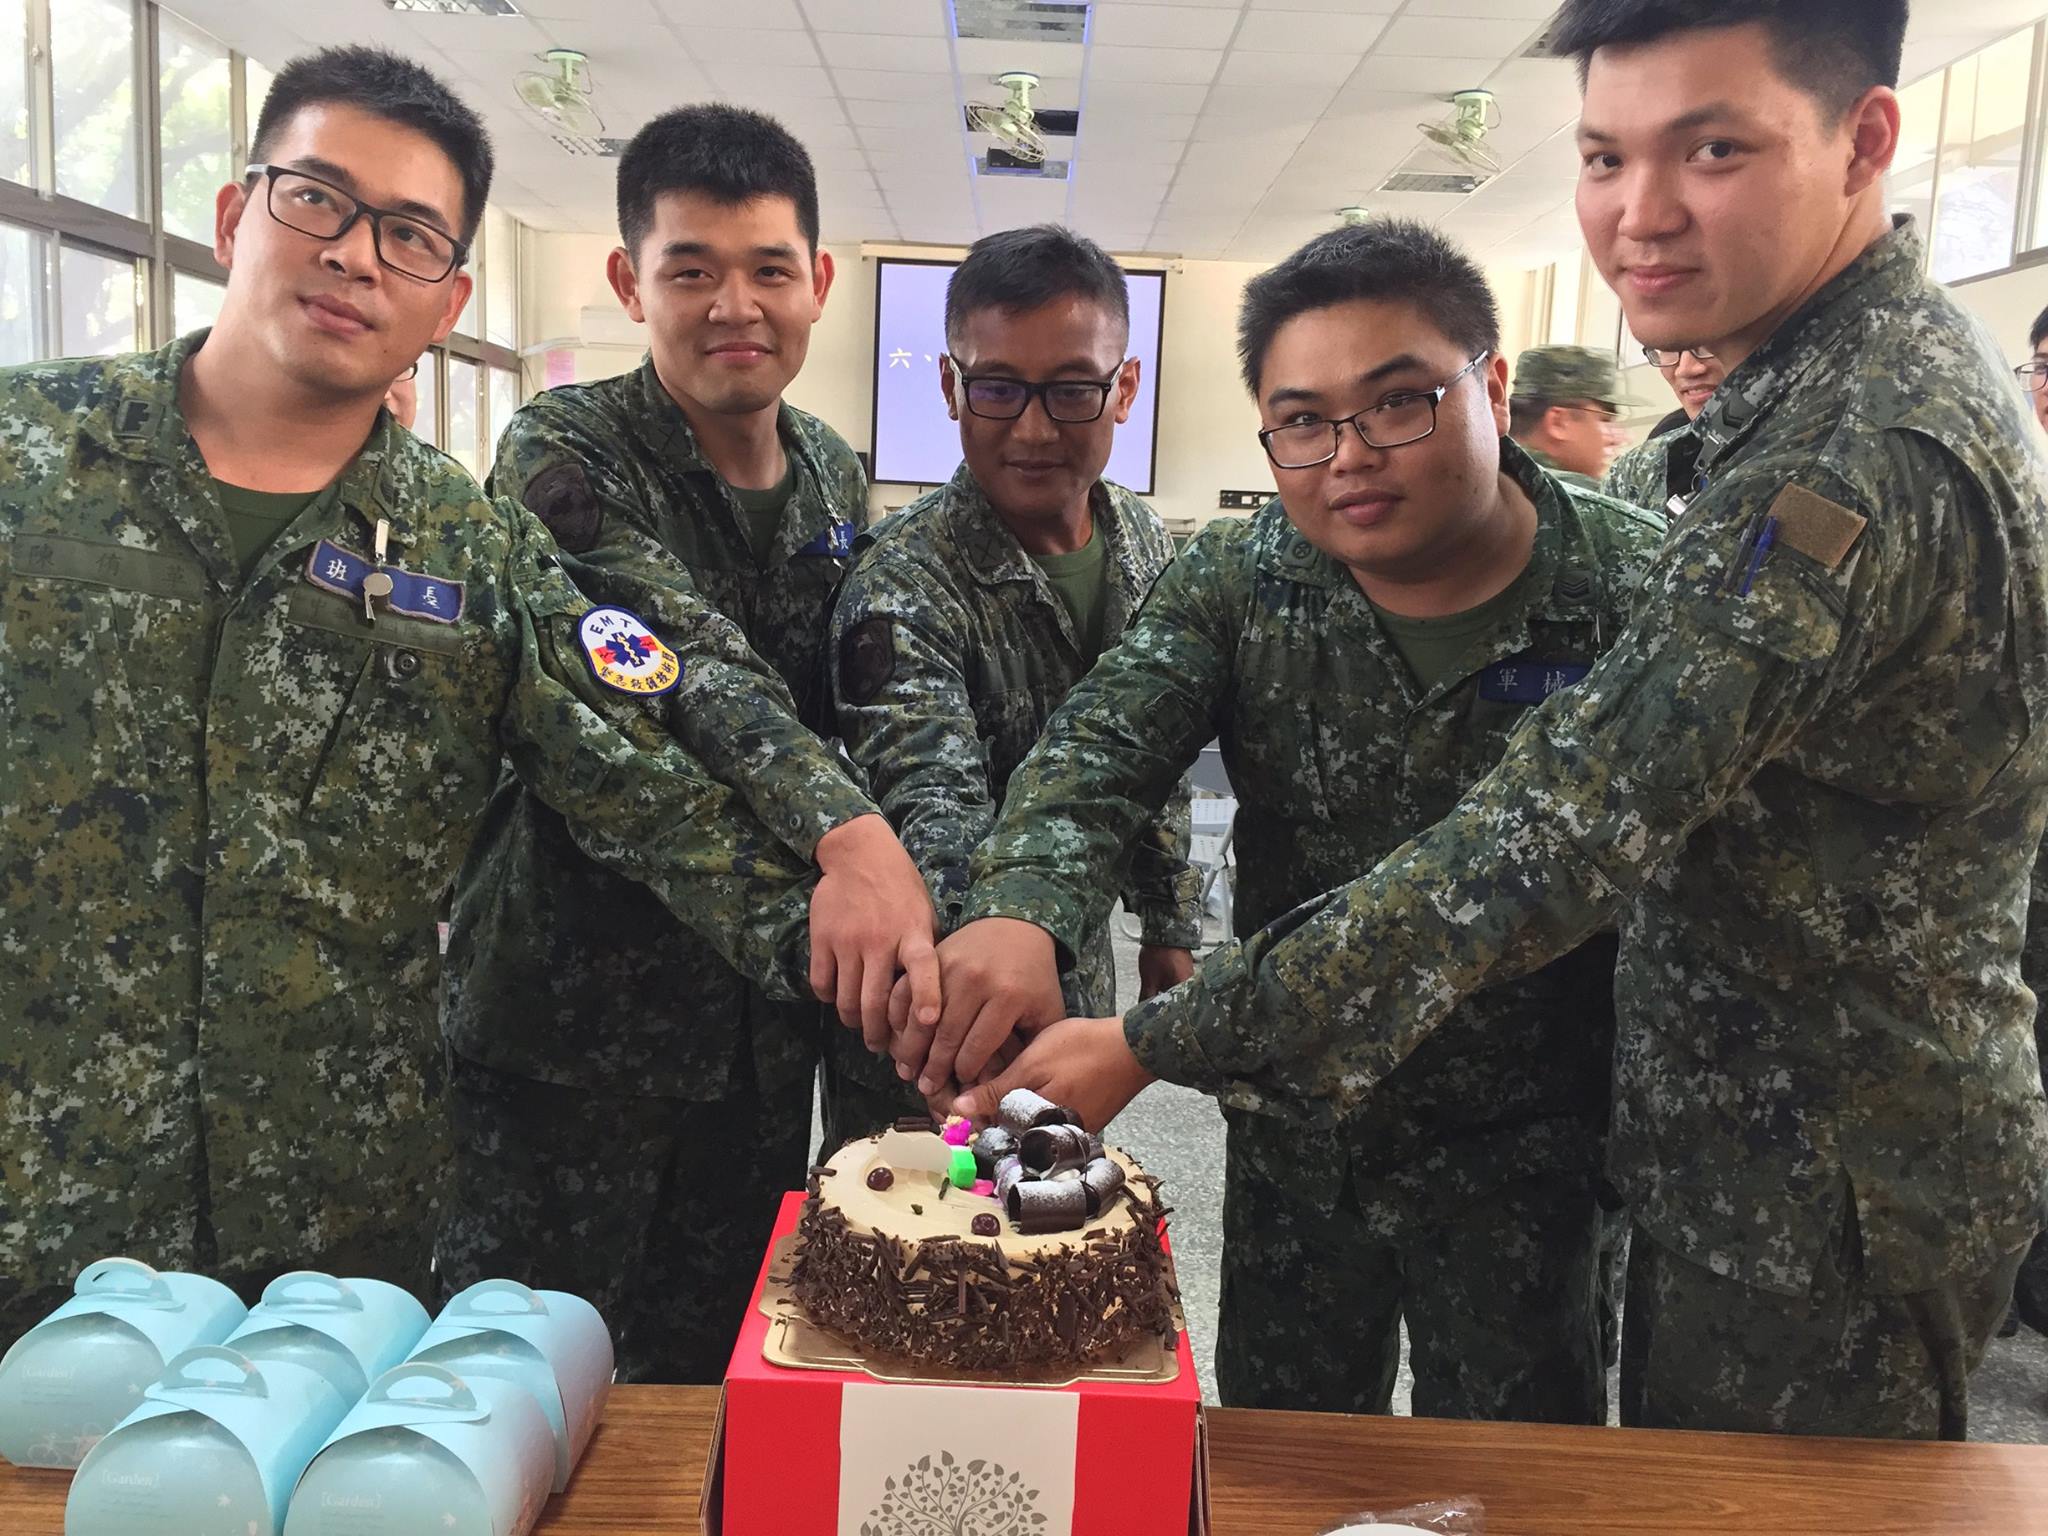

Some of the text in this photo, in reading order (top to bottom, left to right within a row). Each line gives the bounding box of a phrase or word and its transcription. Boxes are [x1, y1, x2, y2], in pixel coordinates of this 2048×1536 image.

[839, 530, 849, 550] 長
[326, 558, 440, 609] 班長
[589, 615, 632, 635] EMT
